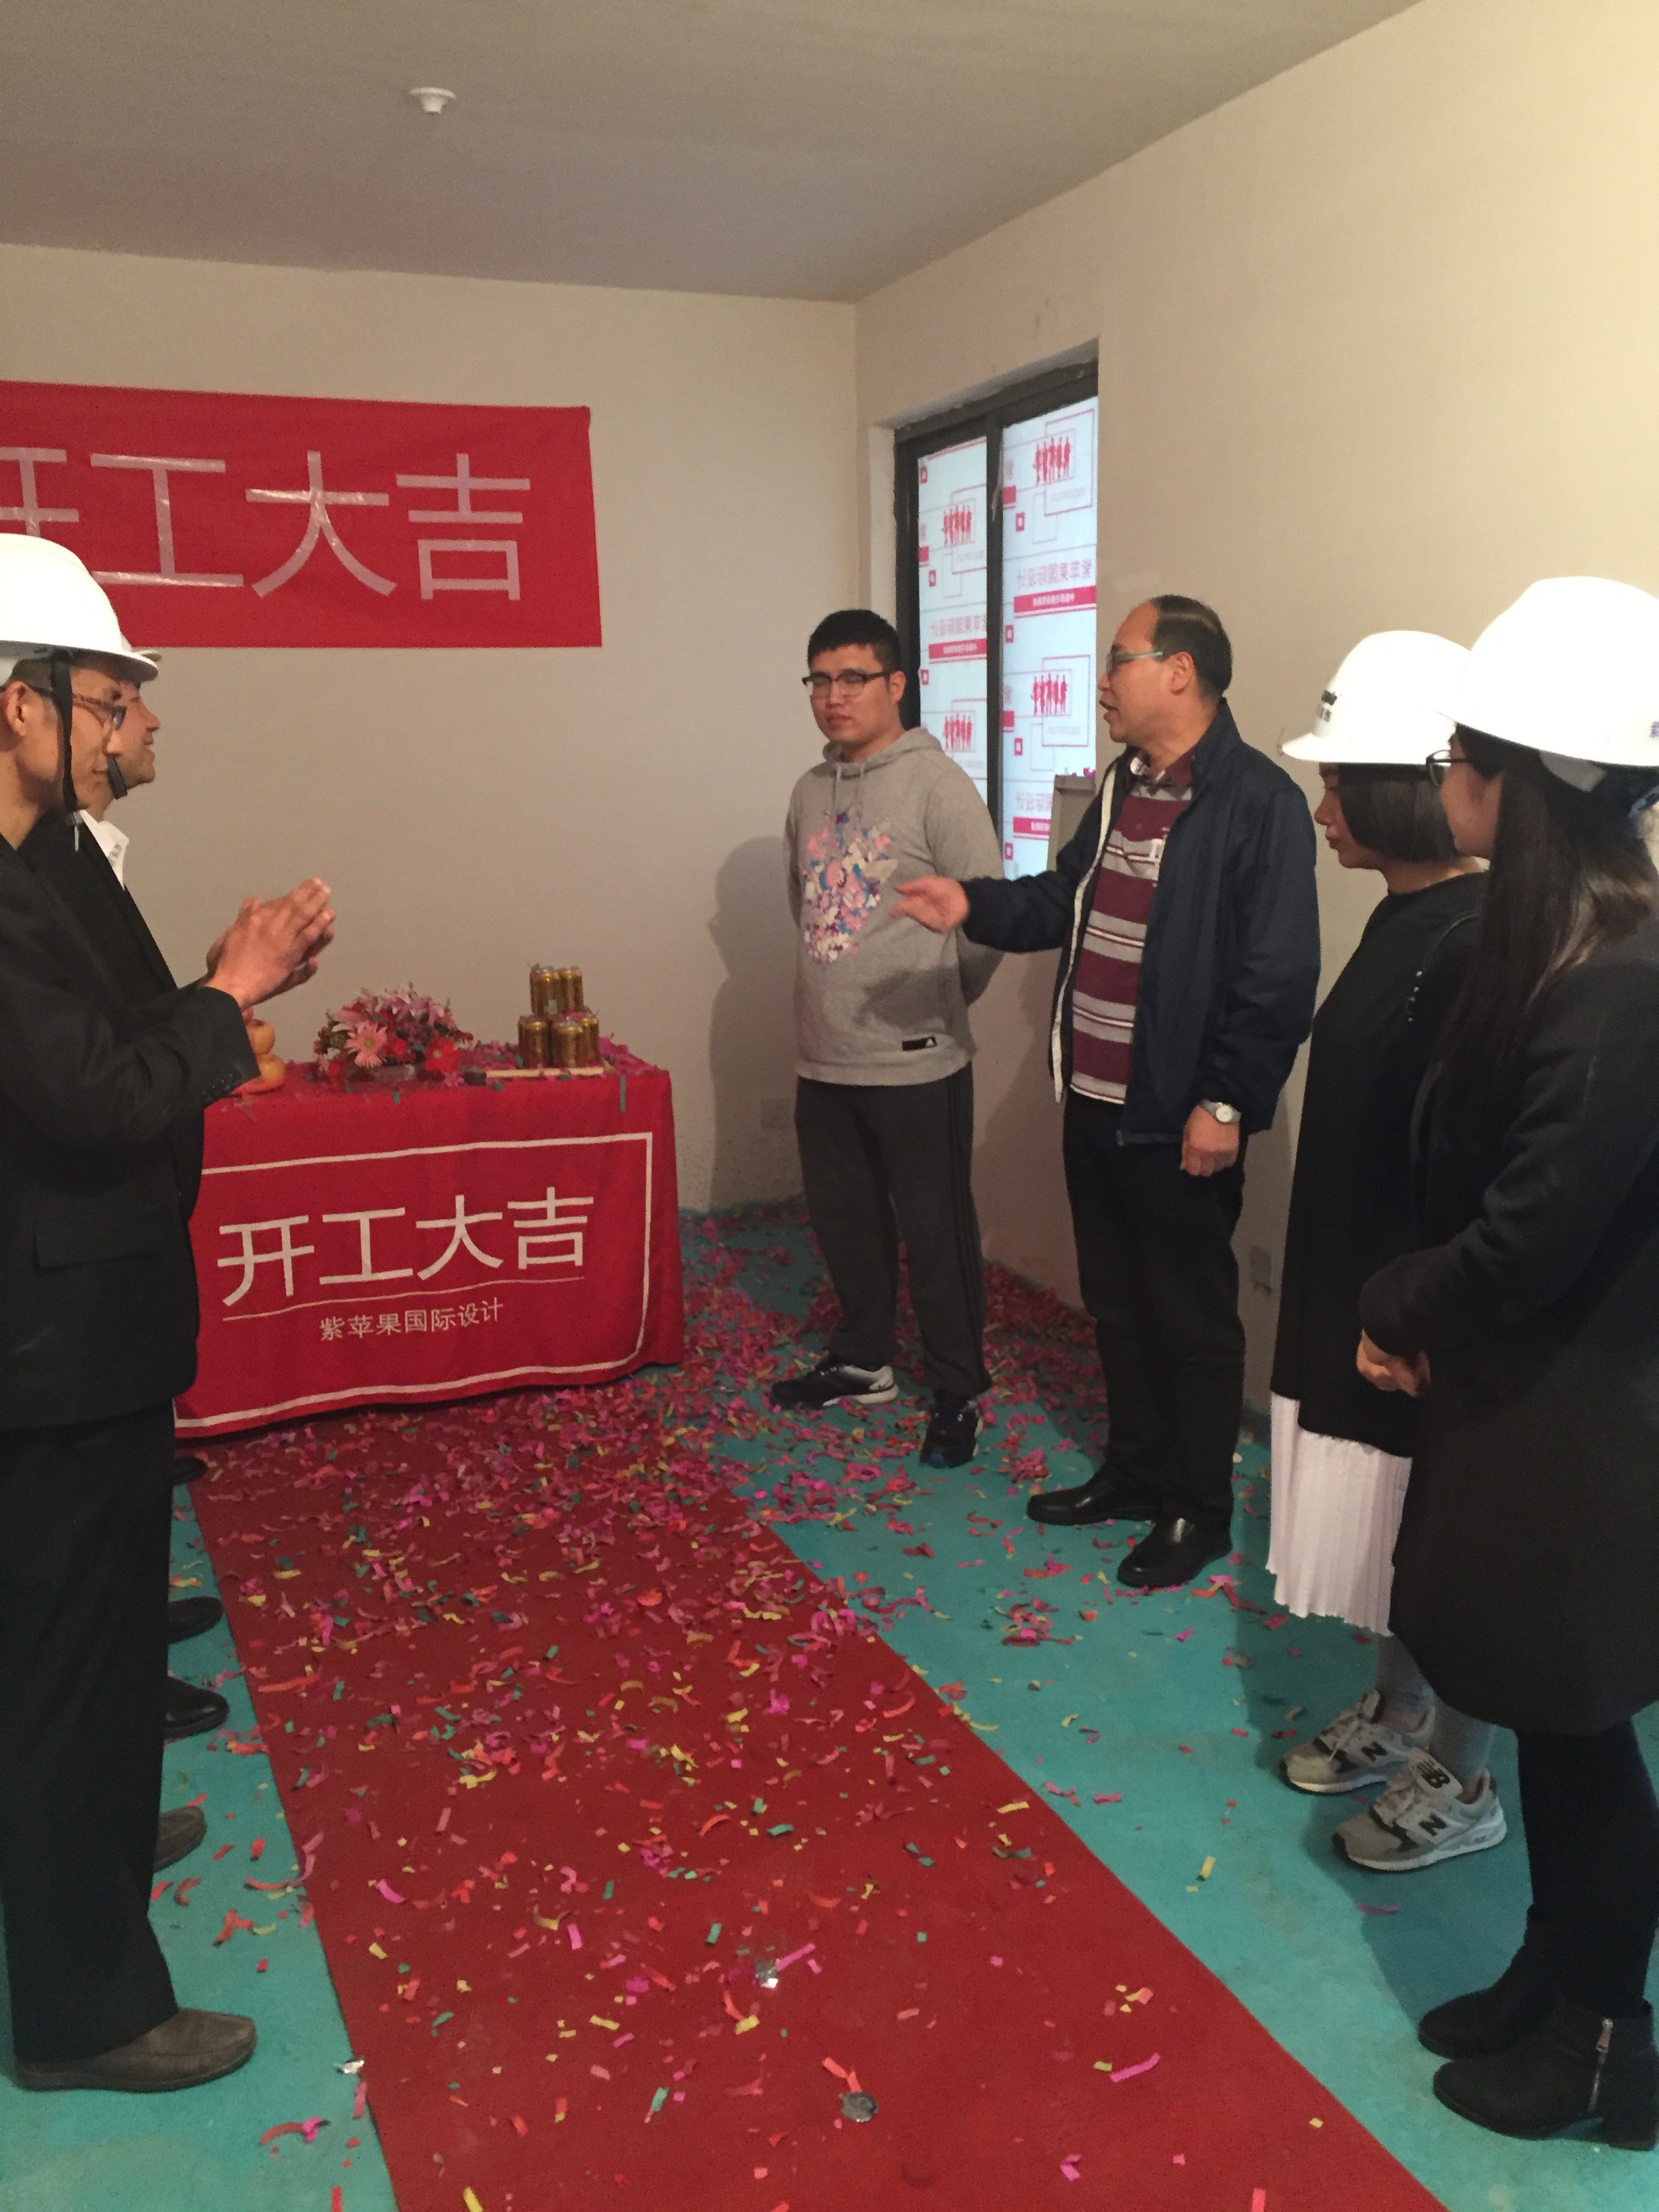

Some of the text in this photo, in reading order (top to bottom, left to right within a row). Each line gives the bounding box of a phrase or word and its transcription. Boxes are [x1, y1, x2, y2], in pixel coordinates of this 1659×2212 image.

[218, 1187, 594, 1307] 开工大吉
[319, 1297, 504, 1340] 紫苹果国际设计
